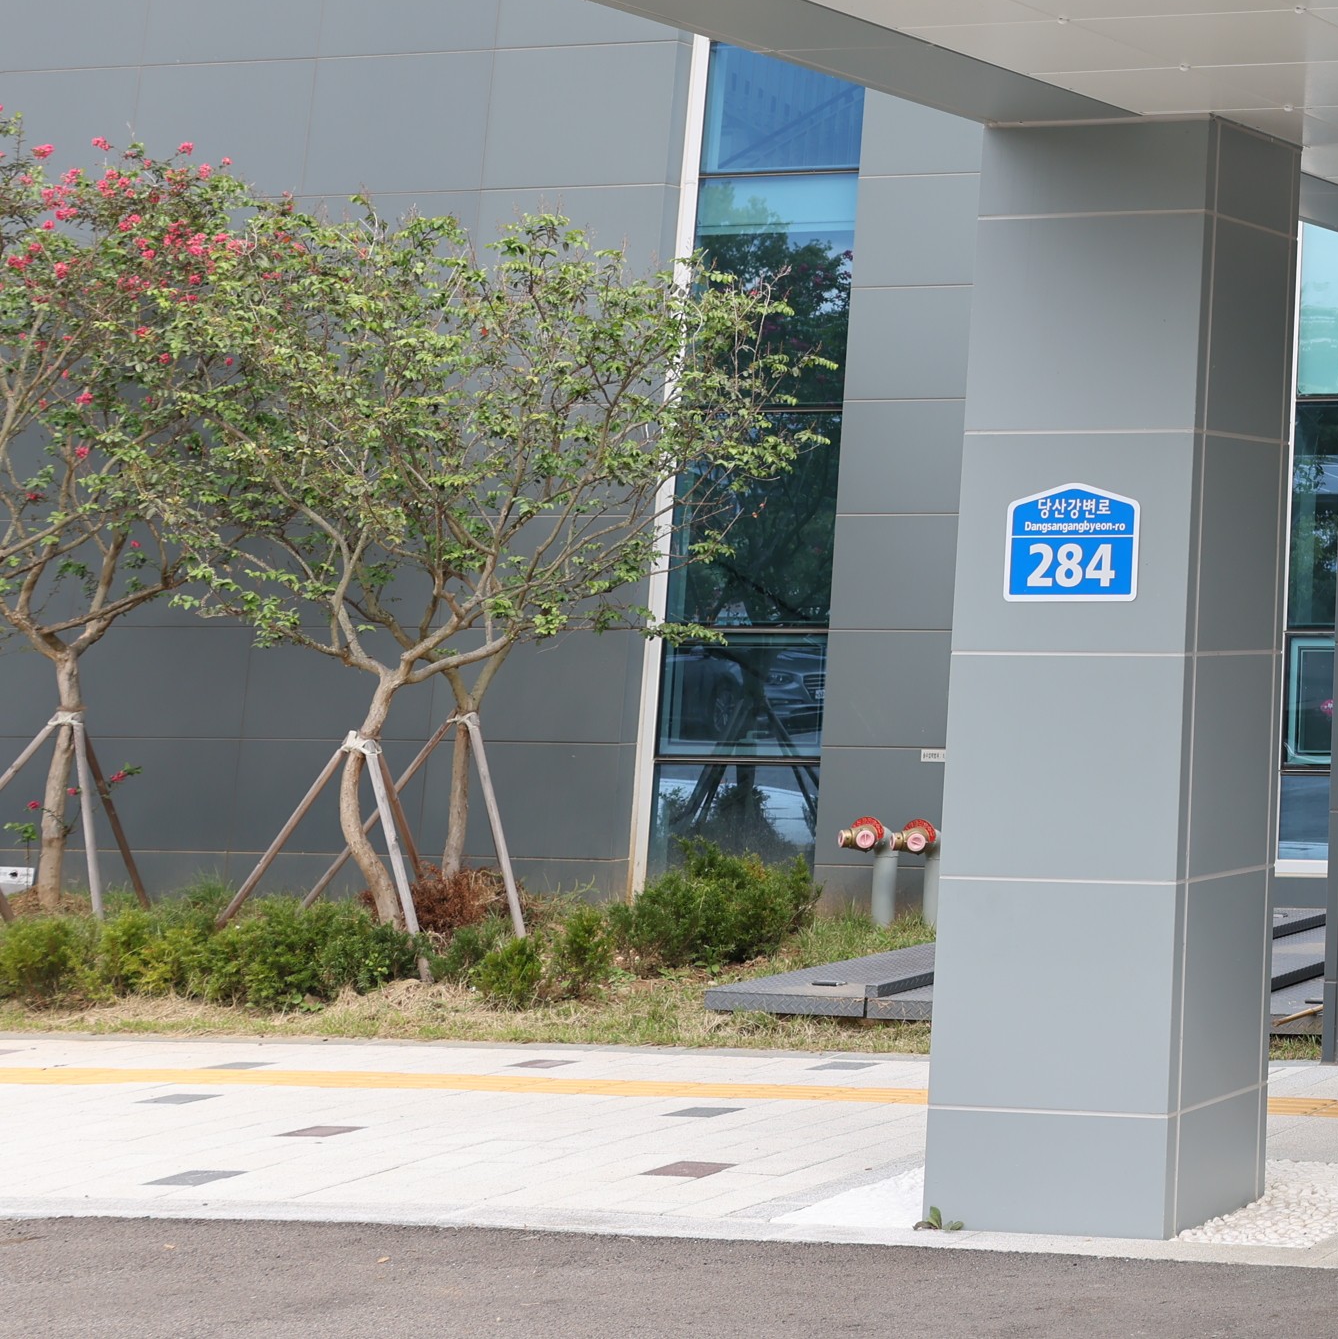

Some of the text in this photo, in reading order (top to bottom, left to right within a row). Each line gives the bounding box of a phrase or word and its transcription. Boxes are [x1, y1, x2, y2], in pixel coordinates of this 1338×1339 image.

[1038, 498, 1111, 518] 당산강변로
[1024, 521, 1126, 533] Dangsangangbyeon-ro
[1026, 543, 1115, 587] 284
